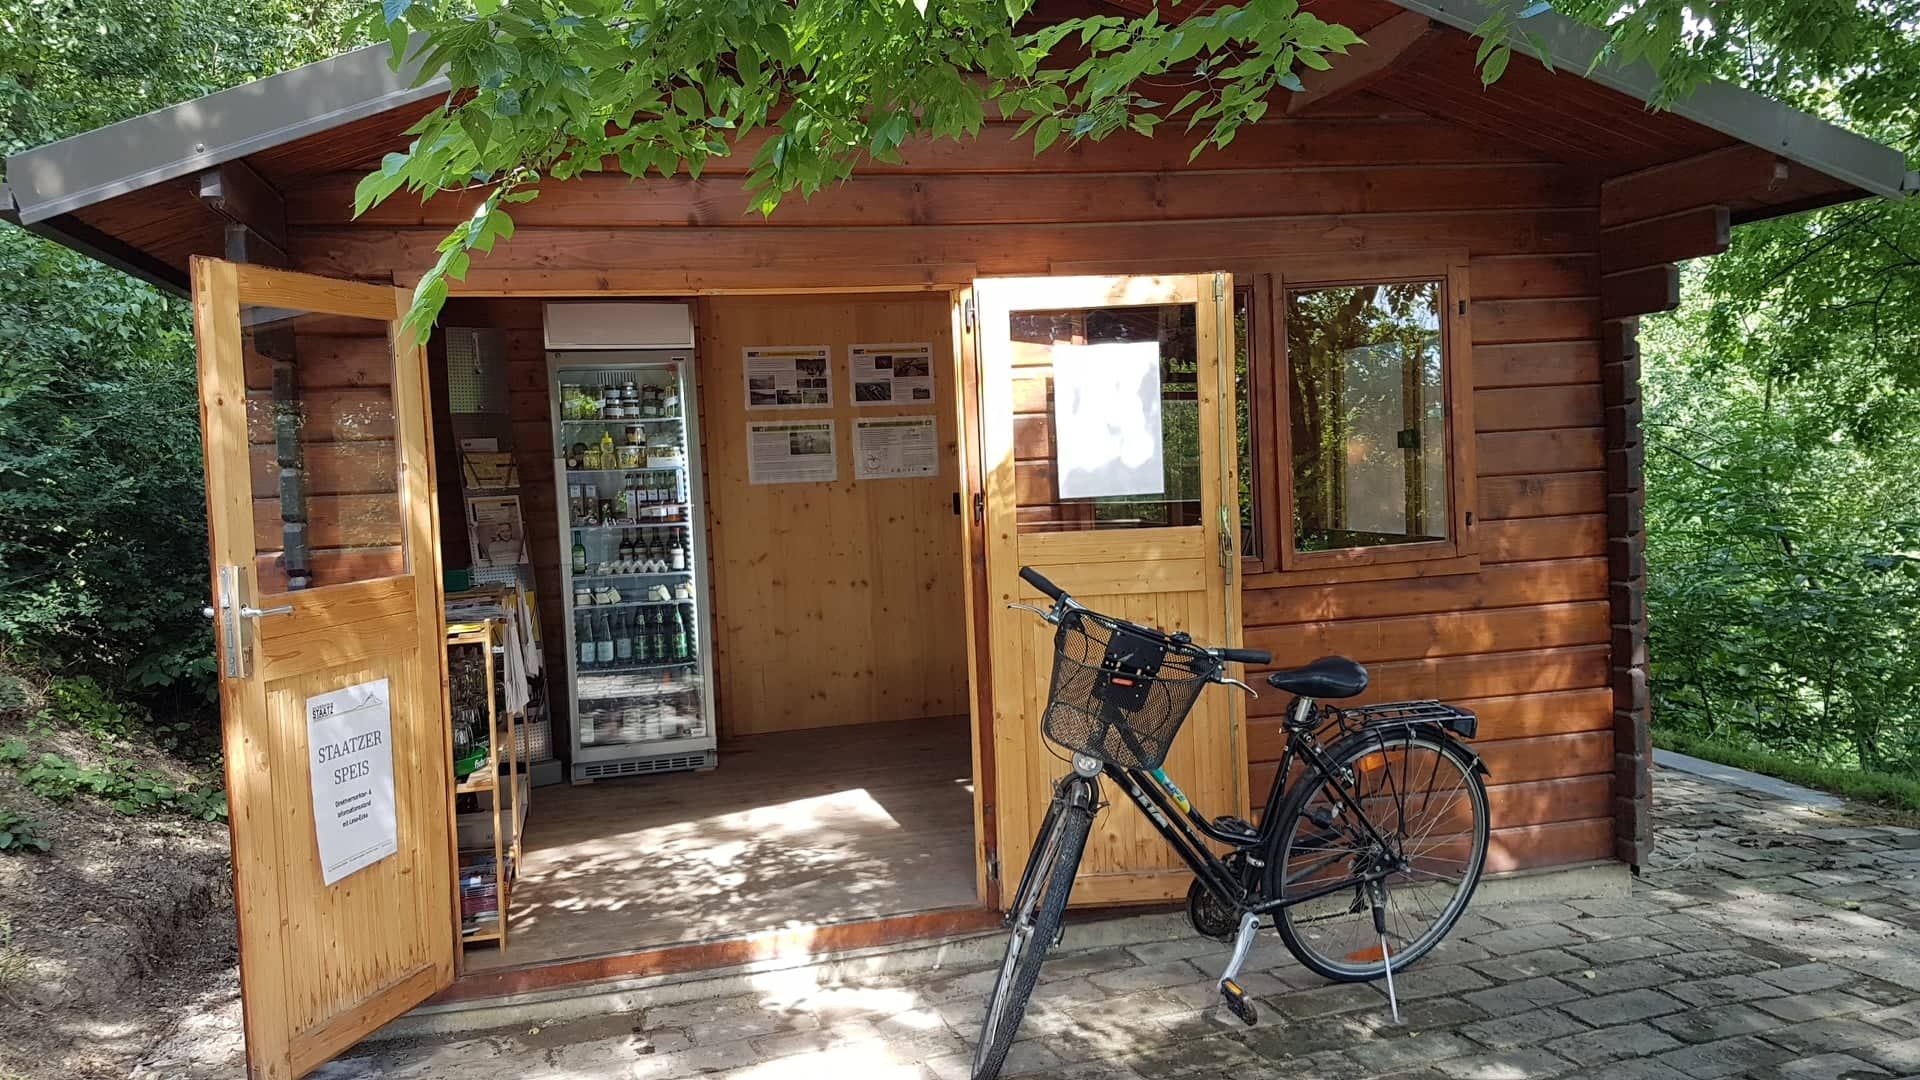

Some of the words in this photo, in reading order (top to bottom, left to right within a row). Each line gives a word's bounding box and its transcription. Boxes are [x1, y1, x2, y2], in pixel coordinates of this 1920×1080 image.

[312, 704, 334, 720] STAATZ
[318, 730, 382, 764] STAATZER
[334, 759, 370, 785] SPEIS
